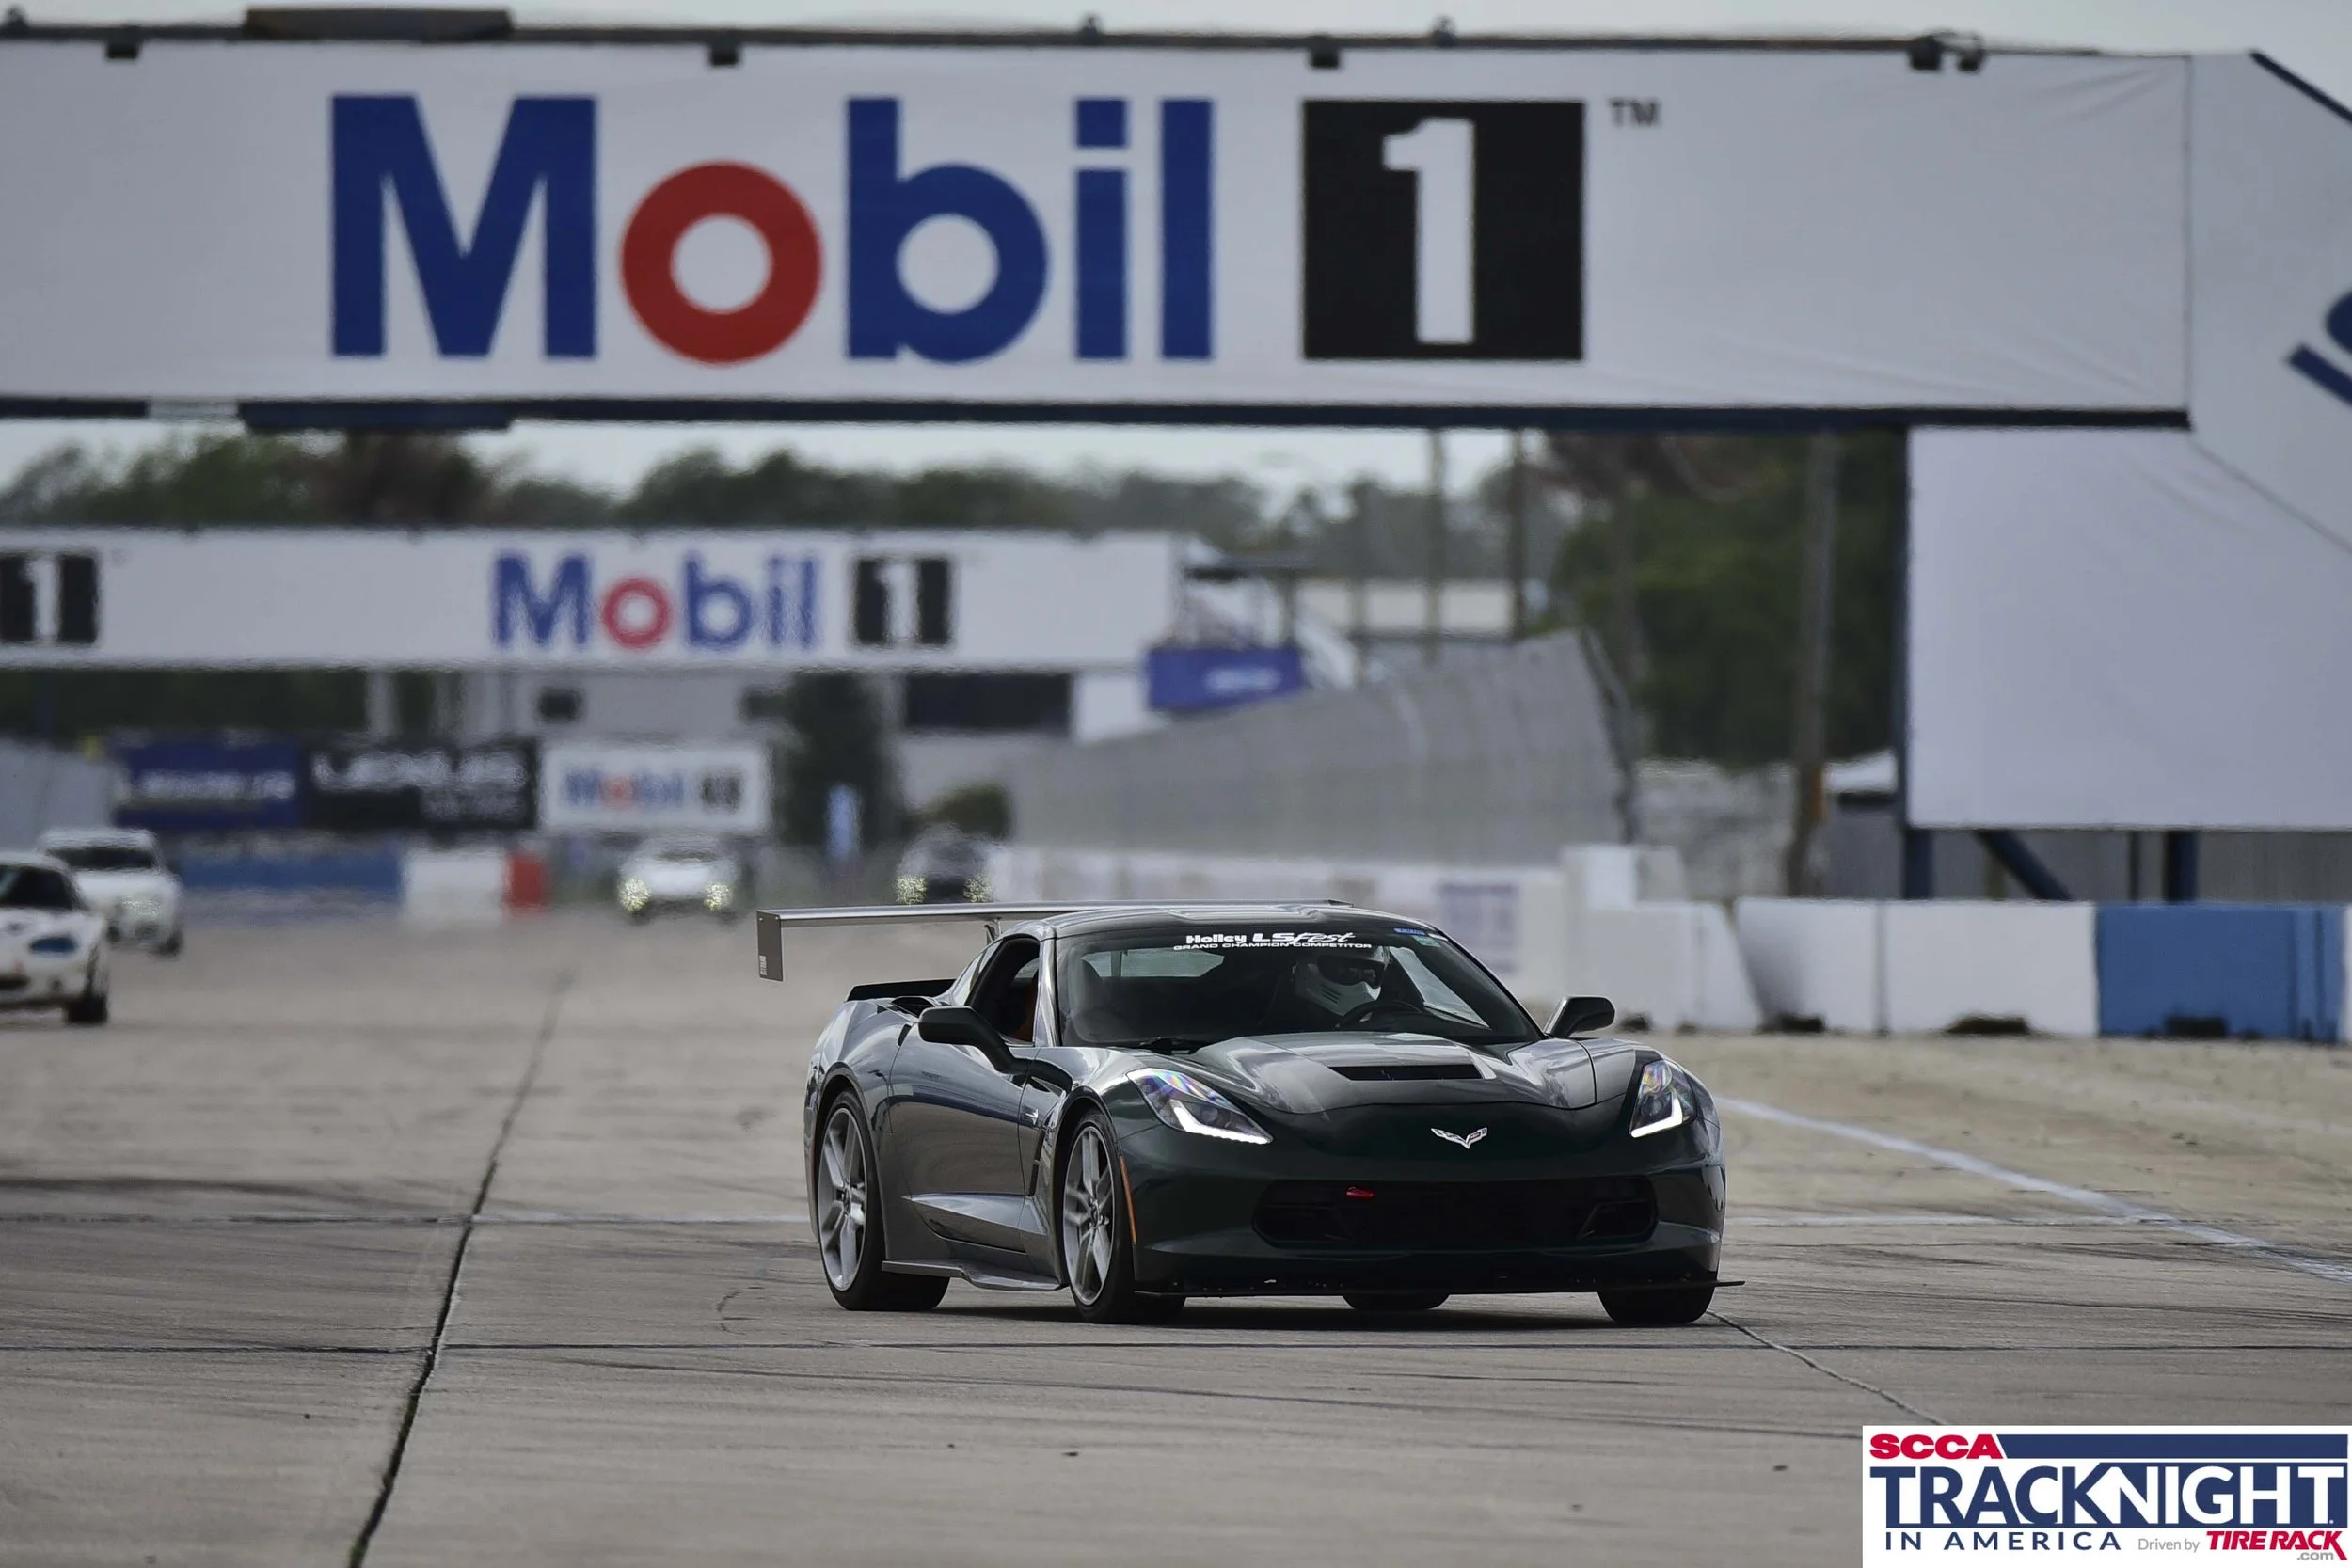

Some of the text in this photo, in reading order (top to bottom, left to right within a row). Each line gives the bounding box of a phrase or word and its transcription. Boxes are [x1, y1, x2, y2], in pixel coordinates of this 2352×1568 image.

[329, 94, 1216, 366] Mobil
[493, 551, 821, 650] Mobil
[1173, 942, 1218, 951] GRAND
[1185, 933, 1247, 944] Holley
